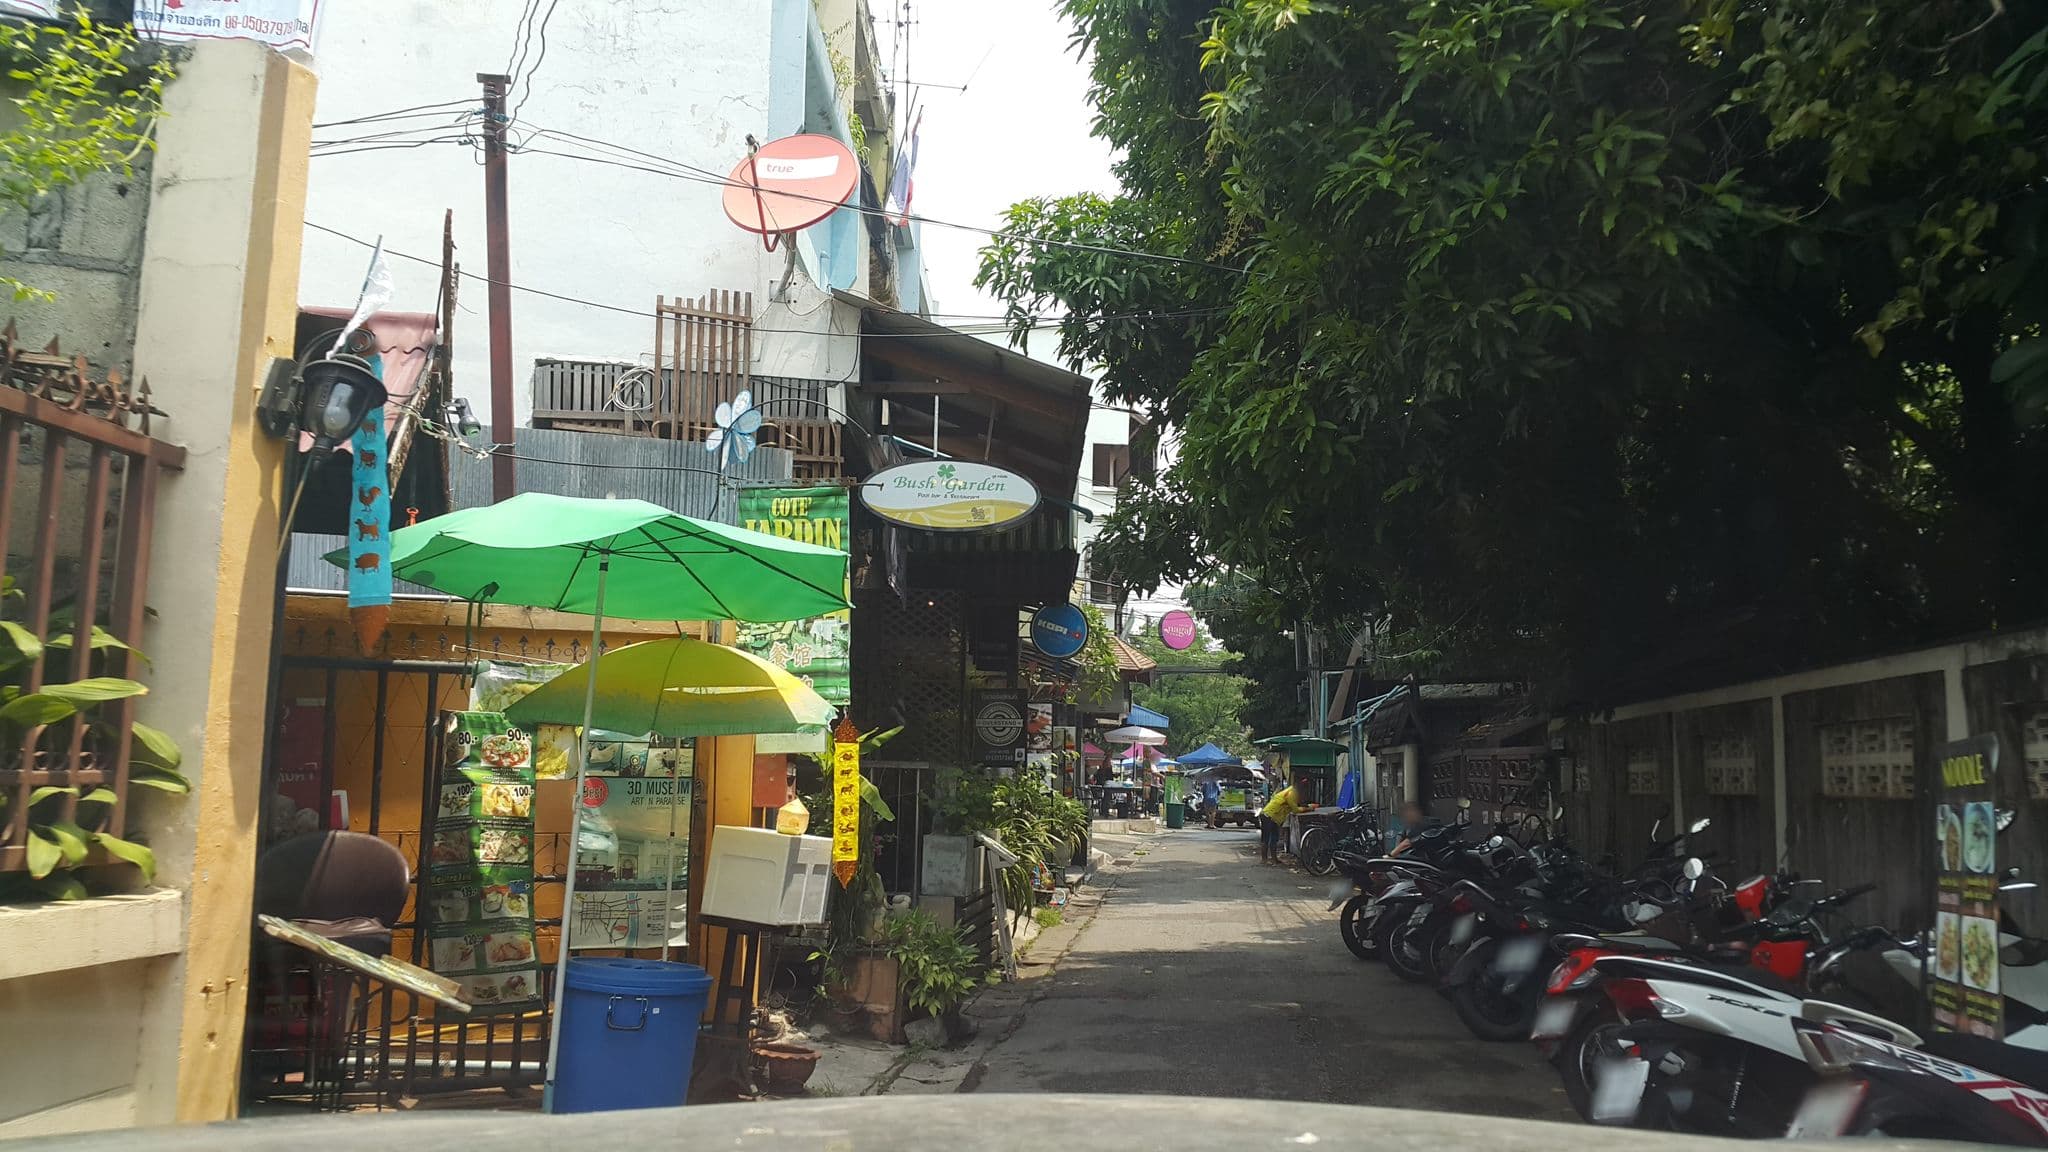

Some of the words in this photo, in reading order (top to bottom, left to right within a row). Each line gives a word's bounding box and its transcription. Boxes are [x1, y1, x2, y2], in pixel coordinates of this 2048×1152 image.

[766, 163, 795, 174] true
[893, 475, 936, 490] Bush
[944, 476, 1007, 494] Garden
[627, 780, 642, 795] 3D
[630, 797, 645, 806] ART
[656, 797, 686, 806] PARASE
